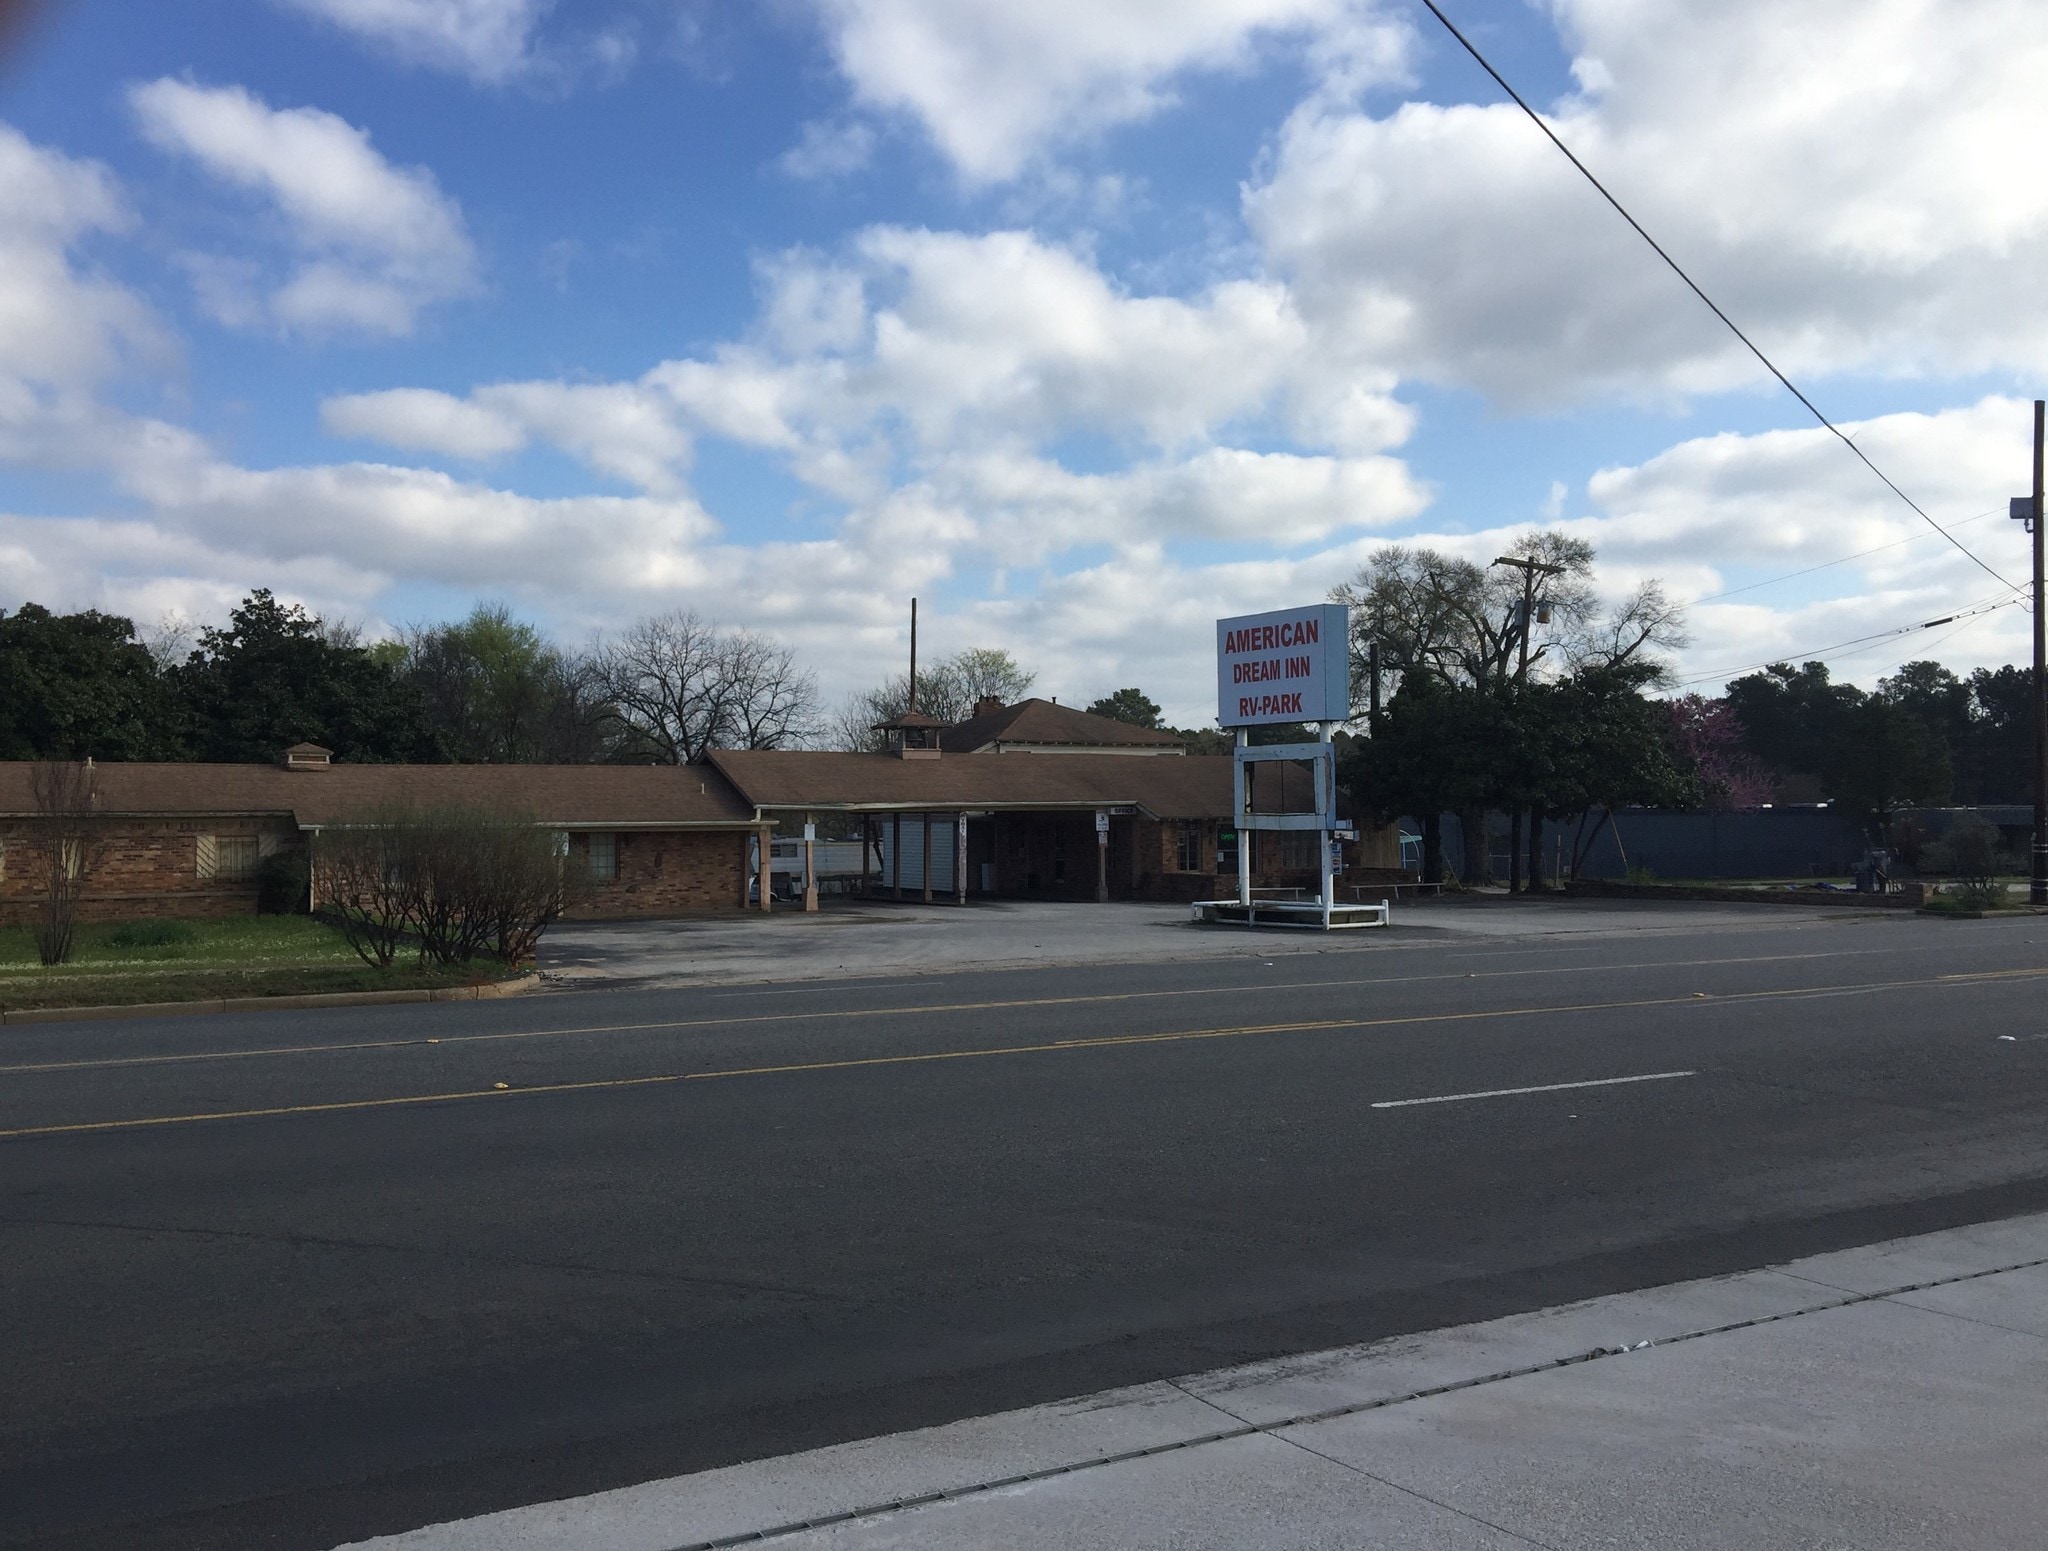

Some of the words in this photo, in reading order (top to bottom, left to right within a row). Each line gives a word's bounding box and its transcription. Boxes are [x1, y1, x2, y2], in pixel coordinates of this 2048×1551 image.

[1225, 619, 1318, 654] AMERICAN
[1233, 659, 1280, 684] DREAM
[1285, 656, 1310, 679] INN
[1239, 693, 1302, 717] RV-PARK
